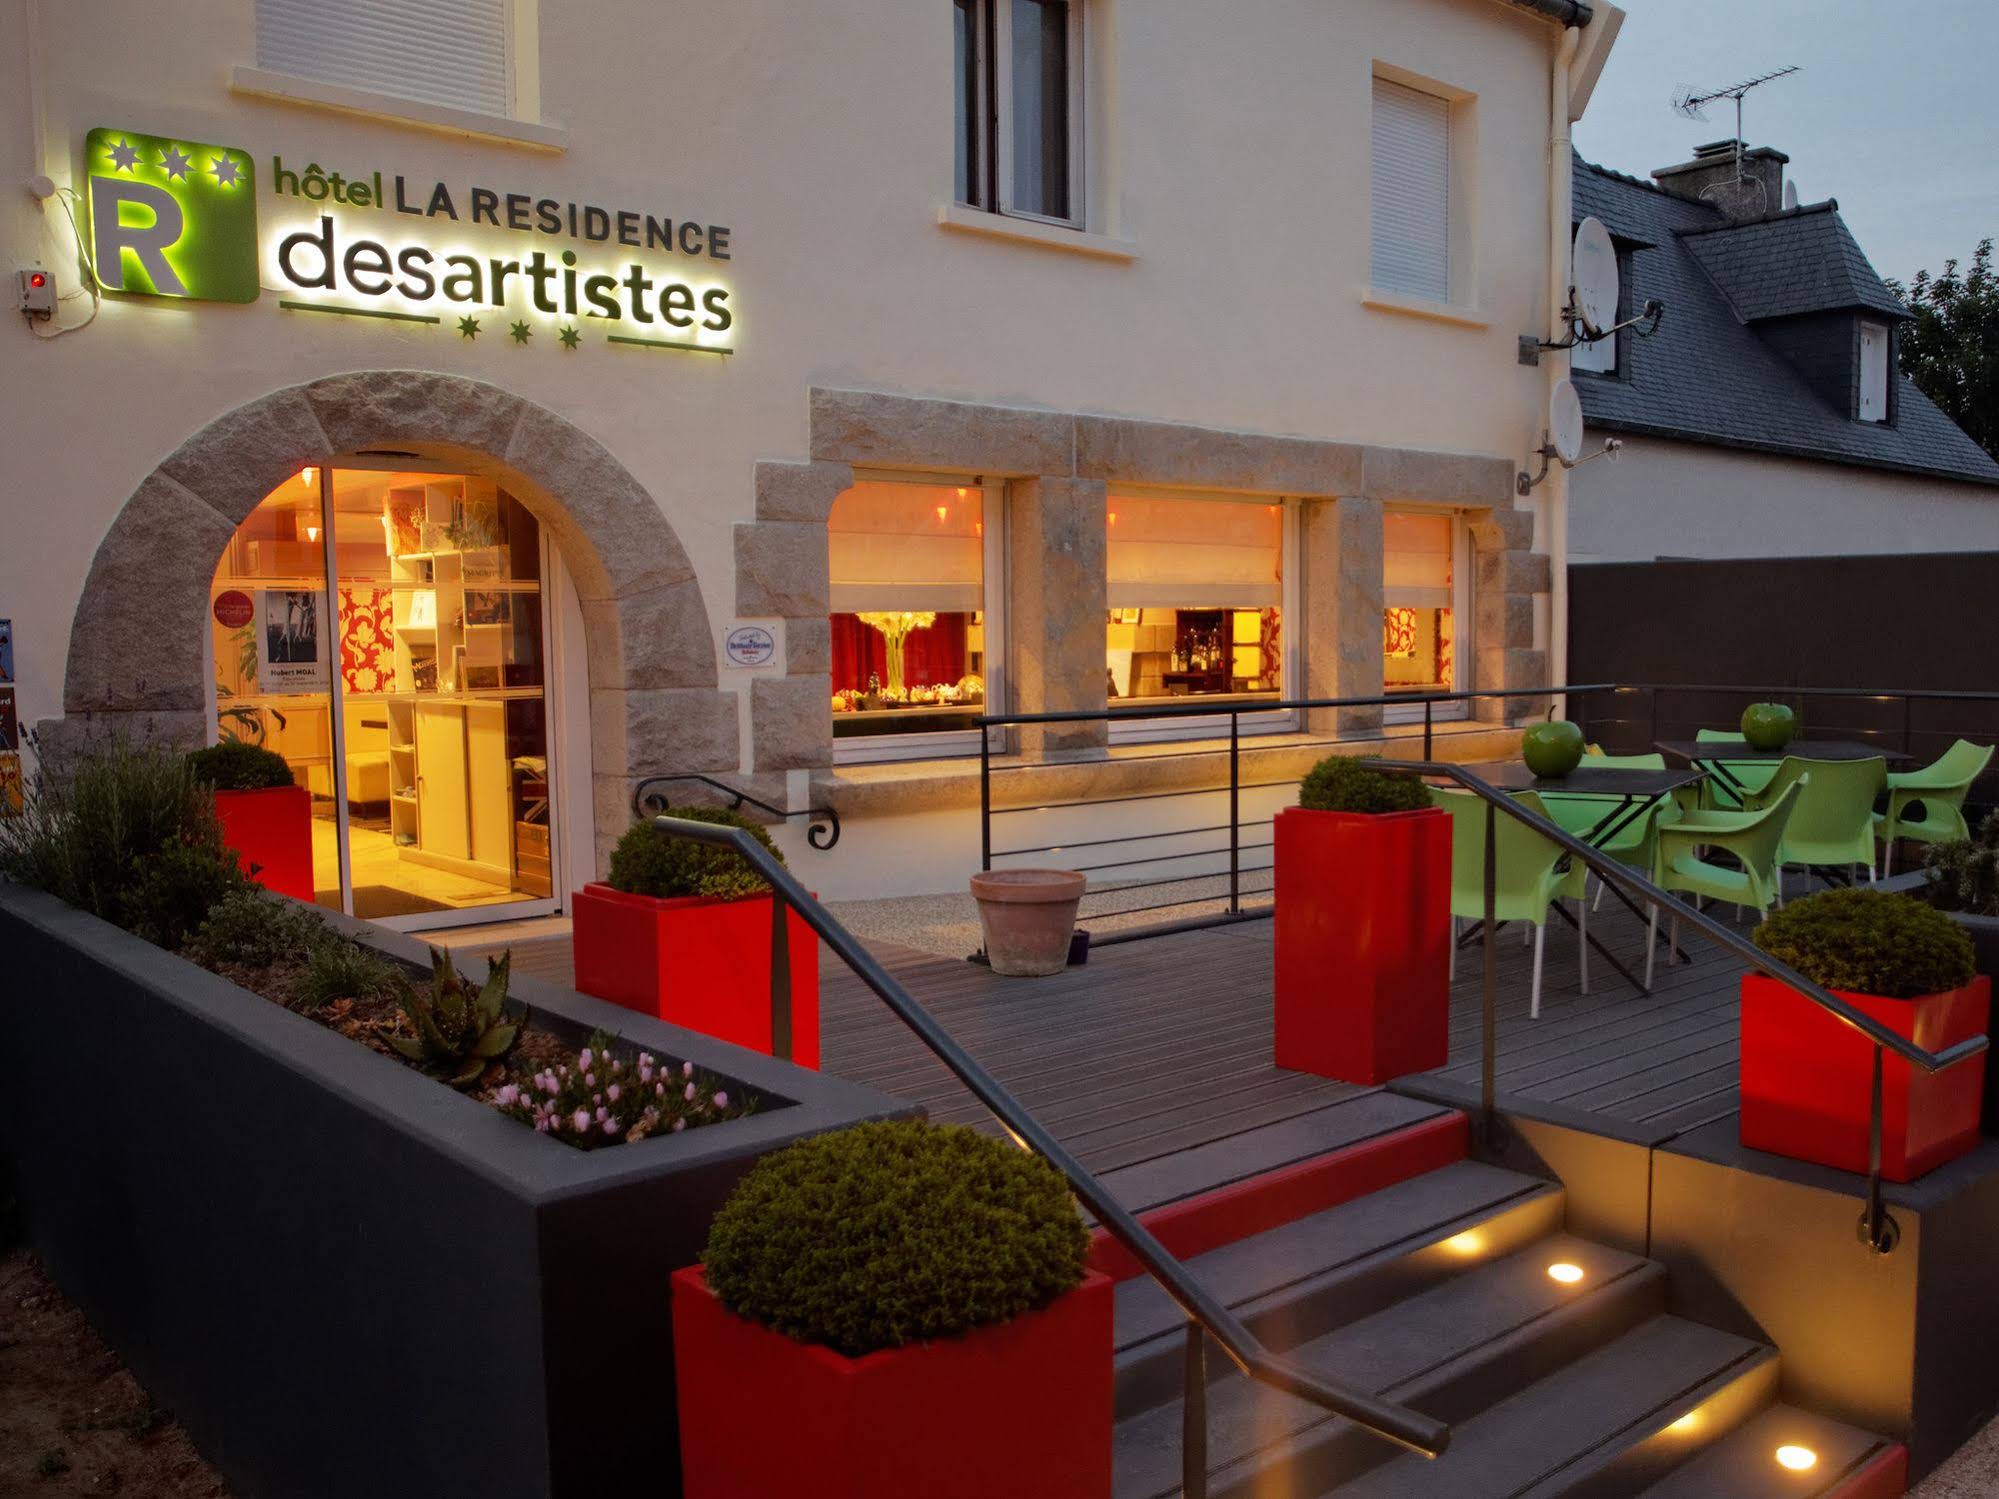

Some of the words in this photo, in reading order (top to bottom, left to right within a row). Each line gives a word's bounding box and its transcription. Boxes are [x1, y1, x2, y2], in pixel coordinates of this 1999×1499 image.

[91, 175, 190, 296] R
[273, 156, 383, 209] hôtel
[395, 175, 459, 221] LA
[471, 187, 731, 260] RESIDENCE
